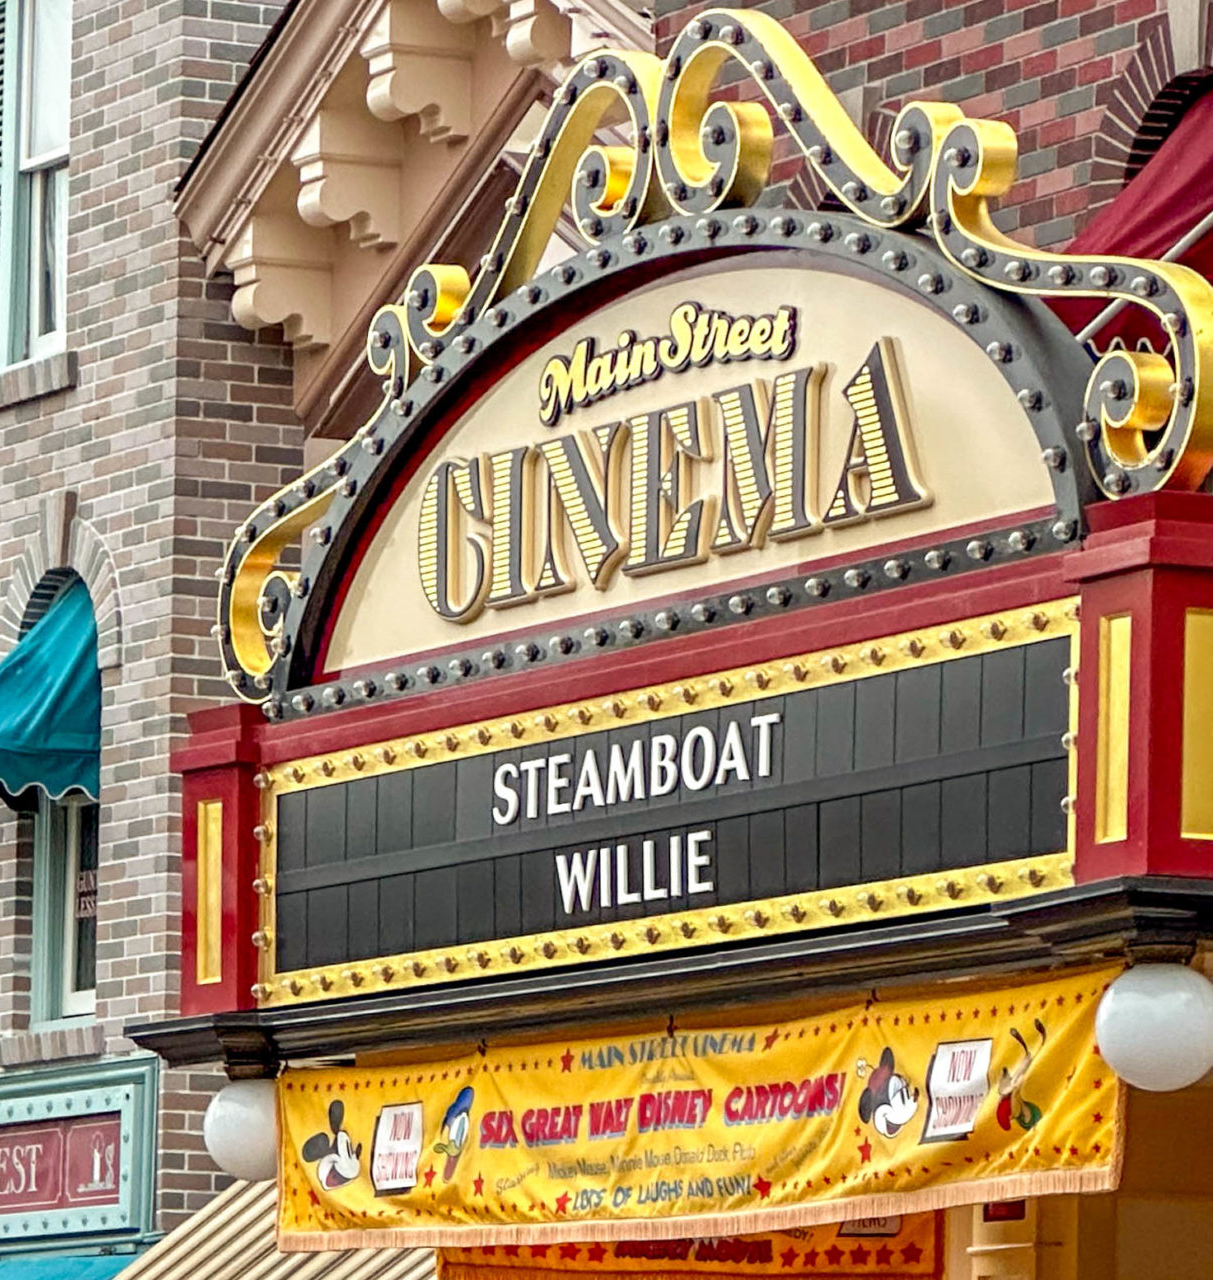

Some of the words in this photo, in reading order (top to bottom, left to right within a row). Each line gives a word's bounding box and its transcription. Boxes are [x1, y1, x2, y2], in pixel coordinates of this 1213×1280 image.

[539, 330, 661, 426] Main
[658, 301, 797, 372] Street
[418, 336, 930, 622] CINEMA
[493, 713, 781, 825] STEAMBOAT
[556, 831, 714, 914] WILLIE
[581, 1046, 625, 1069] MAIN
[692, 1033, 756, 1057] CINEMA
[947, 1050, 977, 1082] NOW
[389, 1111, 413, 1141] NOW
[479, 1110, 519, 1148] SIX
[521, 1104, 583, 1147] GREAT
[588, 1098, 634, 1140] WALT
[638, 1089, 713, 1133] DISNEY
[724, 1073, 847, 1126] CARTOONS!
[613, 1186, 634, 1208] OF
[636, 1179, 683, 1205] LAUGHS
[686, 1175, 715, 1198] AND
[717, 1174, 751, 1197] FUN!
